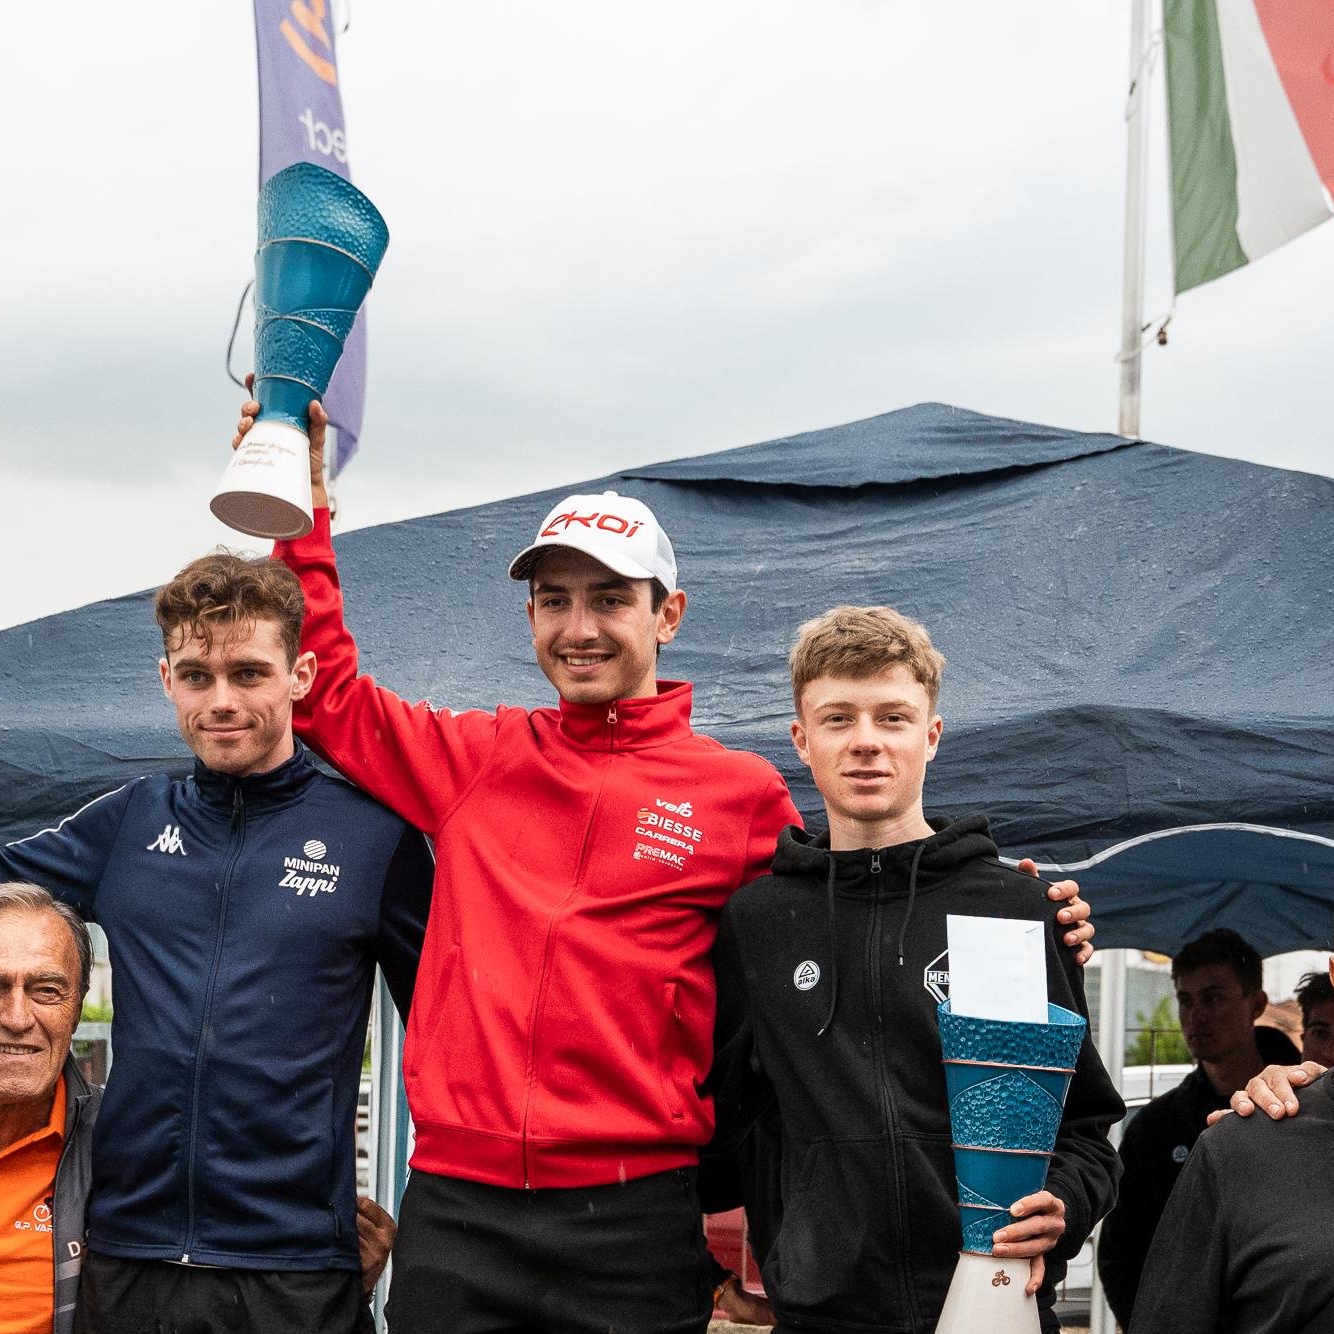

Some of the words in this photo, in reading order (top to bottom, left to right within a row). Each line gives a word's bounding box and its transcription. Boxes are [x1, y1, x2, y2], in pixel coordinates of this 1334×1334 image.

[634, 826, 694, 855] CARRERA
[647, 812, 703, 843] BIESSE
[283, 856, 340, 877] MINIPAN
[634, 842, 686, 867] PREMAC
[278, 868, 338, 897] Zappi
